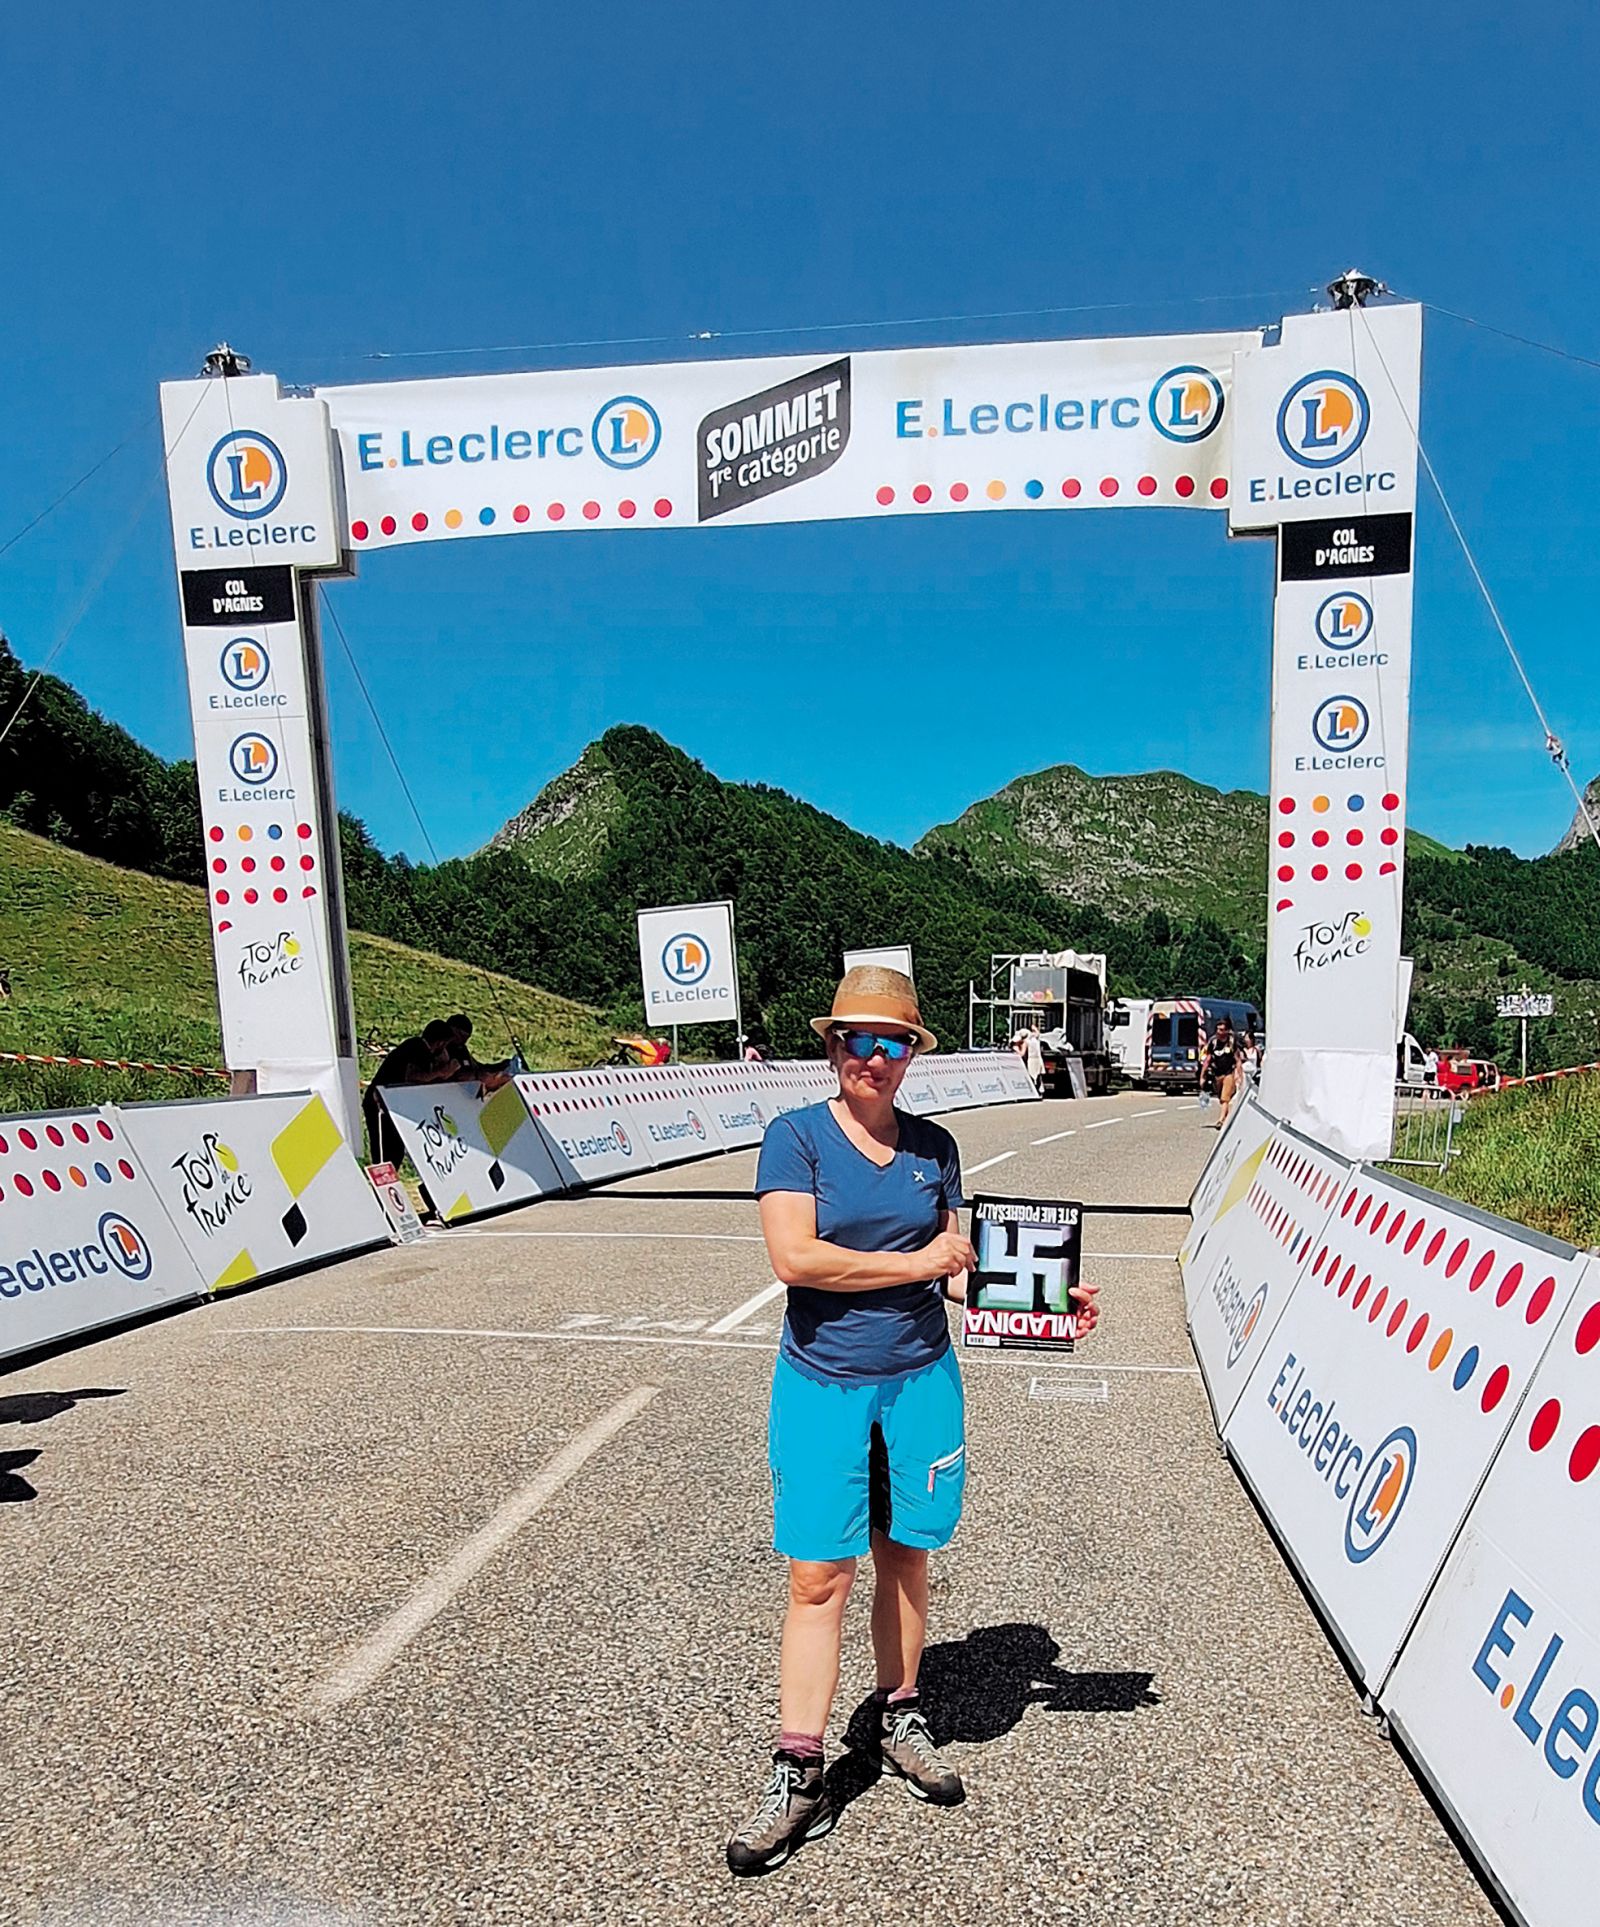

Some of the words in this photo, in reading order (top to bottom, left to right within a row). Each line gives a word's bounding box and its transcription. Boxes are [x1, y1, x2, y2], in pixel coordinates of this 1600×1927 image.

[706, 380, 842, 469] SOMMET
[896, 394, 1140, 438] E.Leclerc
[358, 425, 583, 471] E.Leclerc
[709, 466, 732, 498] 1re
[738, 427, 840, 487] catégorie
[1250, 465, 1395, 503] E.Leclerc
[190, 523, 316, 549] E.Leclerc
[1332, 529, 1358, 546] COL
[1315, 546, 1374, 566] D'AGNES
[225, 580, 248, 596] COL
[212, 596, 264, 614] D'AGNES
[1298, 651, 1389, 670] E.Leclerc
[209, 692, 287, 709] E.Leclerc
[1295, 754, 1385, 771] E.Leclerc
[219, 787, 295, 802] E.Leclerc
[651, 986, 729, 1004] E.Leclerc
[561, 1135, 617, 1159] E.Leclerc
[1041, 1206, 1057, 1224] ME
[1057, 1207, 1079, 1225] STE
[965, 1310, 1077, 1338] MLADINA
[1267, 1352, 1363, 1500] E.Leclerc
